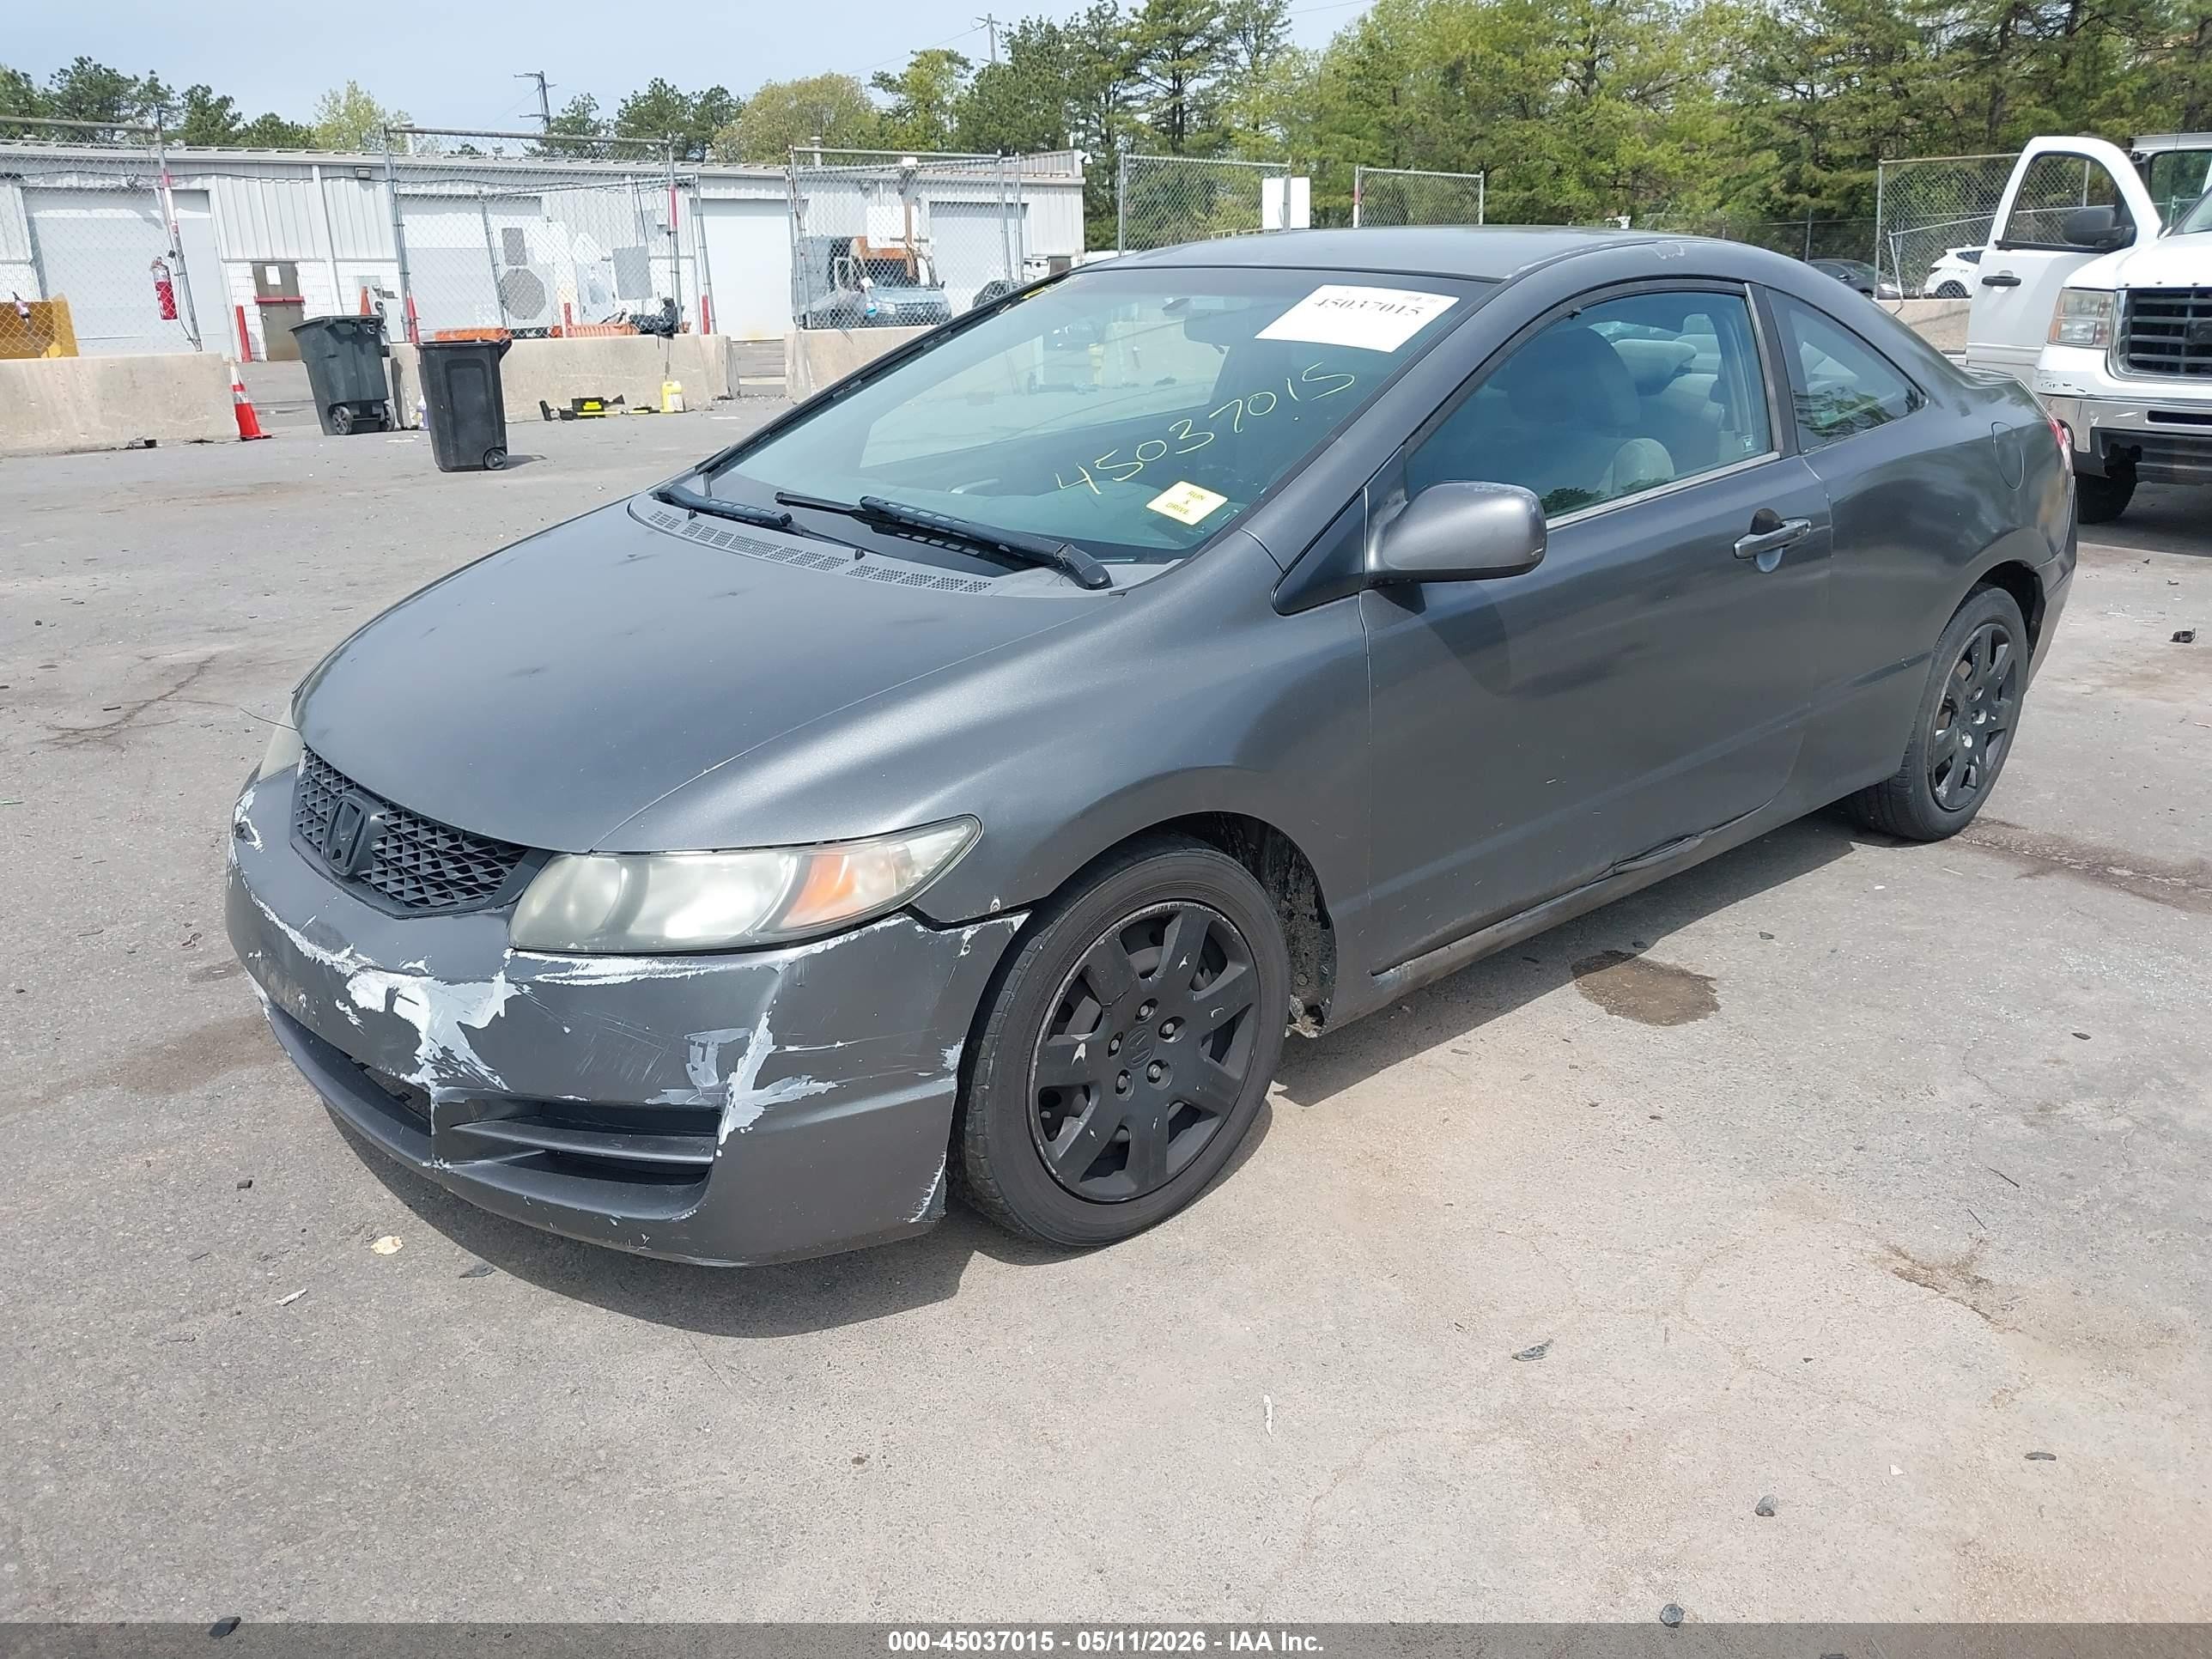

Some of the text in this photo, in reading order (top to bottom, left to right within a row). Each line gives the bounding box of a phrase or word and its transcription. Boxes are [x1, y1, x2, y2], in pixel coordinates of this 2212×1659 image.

[1314, 297, 1426, 317] 45037015
[1054, 361, 1356, 495] 45037015
[1187, 490, 1206, 501] RUN
[1165, 502, 1190, 515] DRIVE
